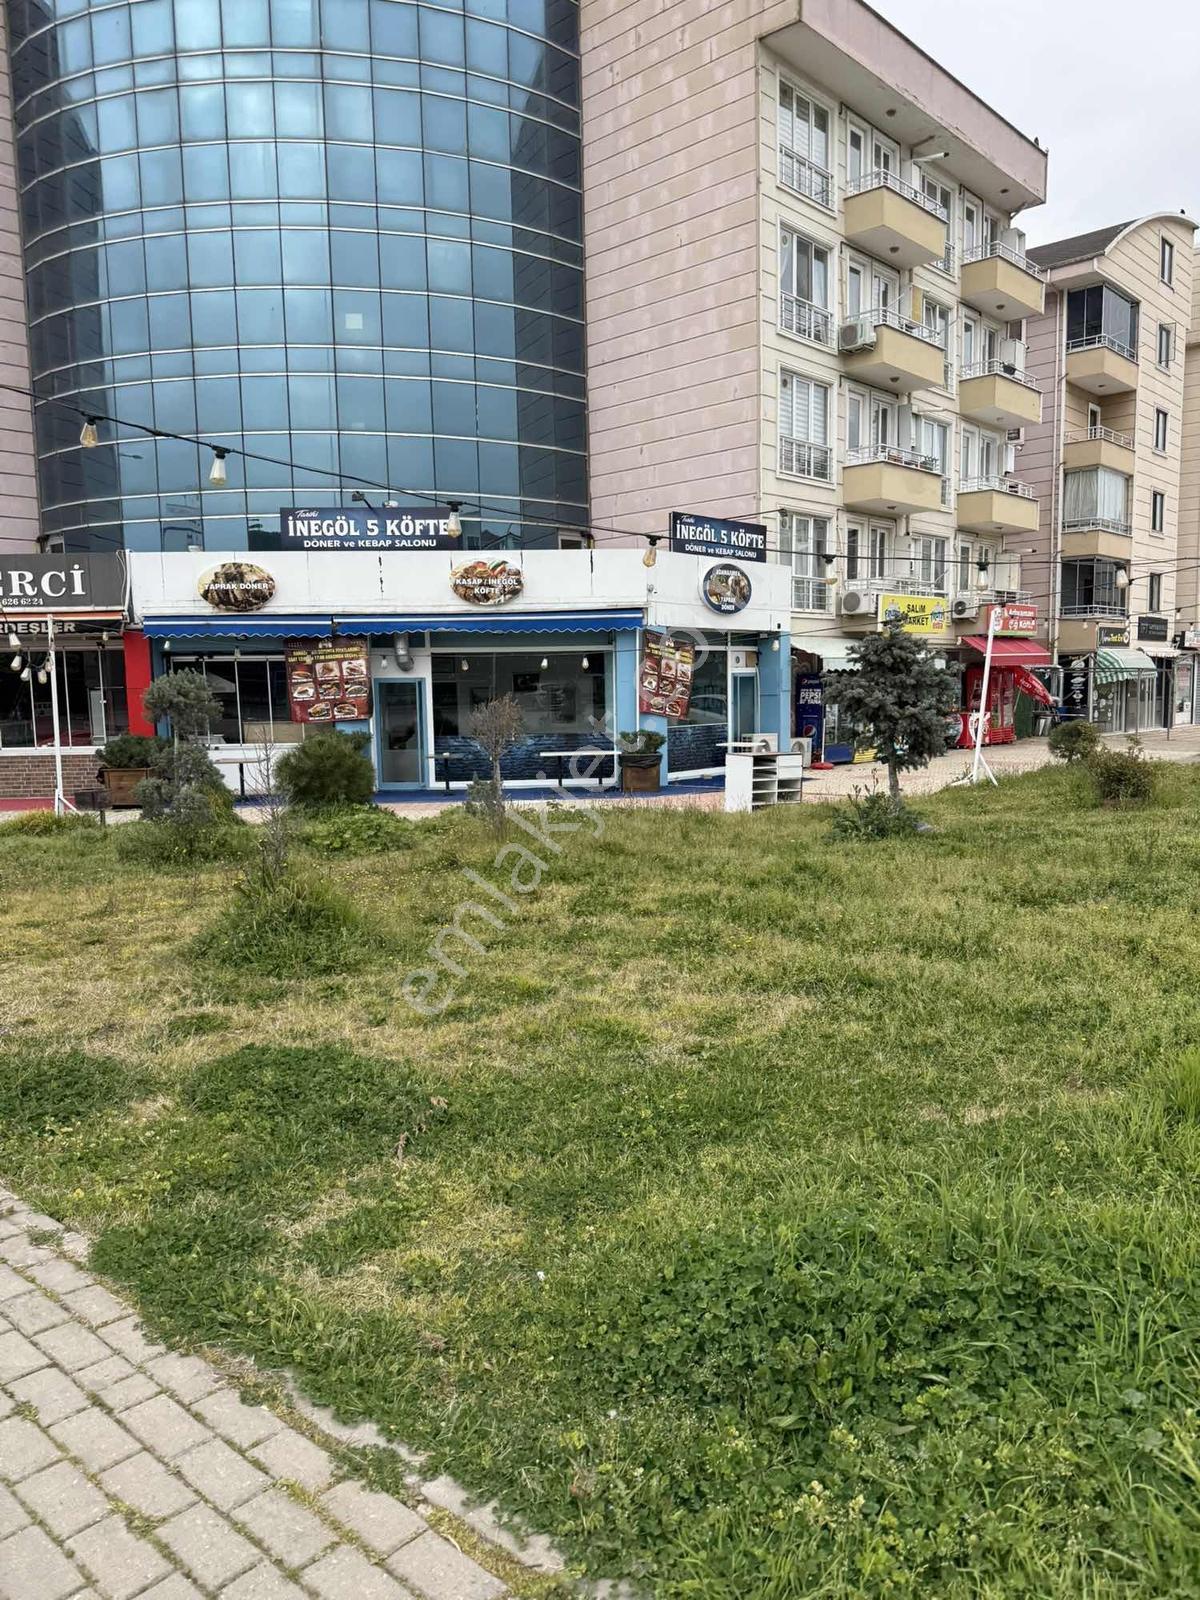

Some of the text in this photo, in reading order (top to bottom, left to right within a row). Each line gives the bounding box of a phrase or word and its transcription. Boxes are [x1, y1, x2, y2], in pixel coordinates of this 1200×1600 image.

[287, 515, 449, 537] İNEGÖL 5 KÖFTE
[676, 520, 764, 549] İNEGÖL 5 KÖFTE
[303, 538, 341, 548] DÖNER
[358, 539, 393, 548] KEBAP
[395, 538, 437, 547] SALONU
[685, 543, 707, 554] DÖNER
[715, 547, 734, 556] KEBAP
[734, 549, 757, 559] SALONU
[0, 564, 86, 597] RCİ
[240, 581, 269, 590] DÖNER
[456, 578, 483, 586] KASAP
[474, 586, 500, 595] KÖFTE
